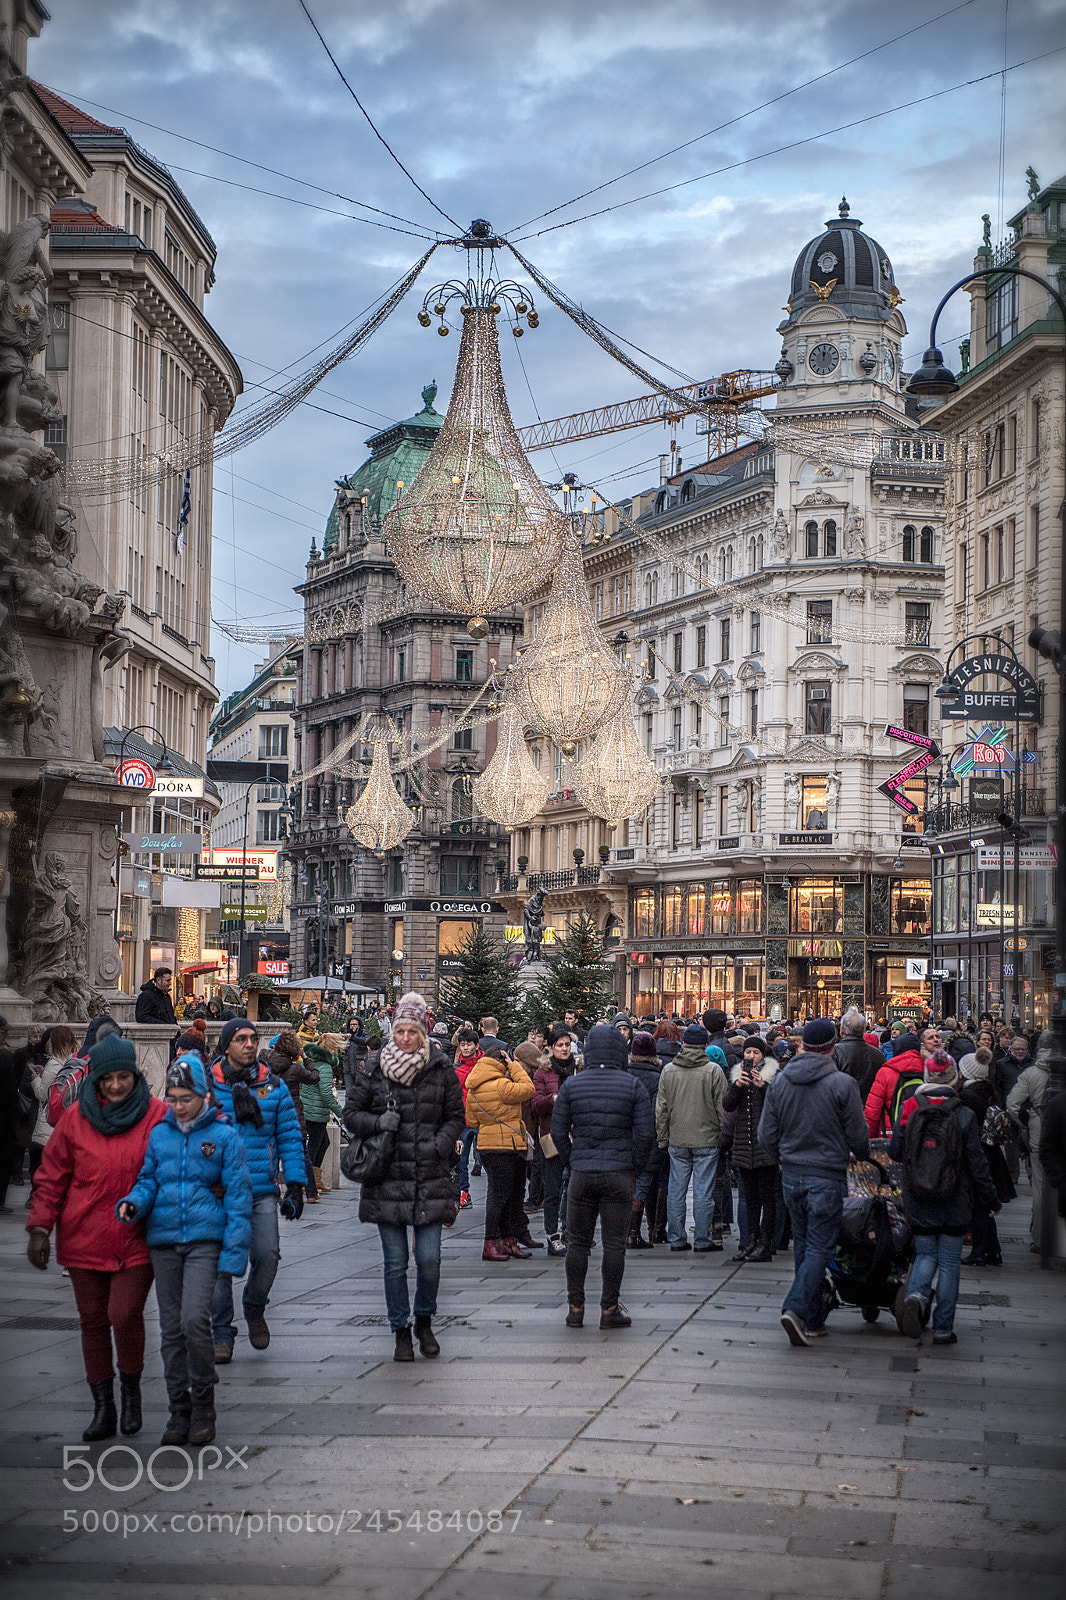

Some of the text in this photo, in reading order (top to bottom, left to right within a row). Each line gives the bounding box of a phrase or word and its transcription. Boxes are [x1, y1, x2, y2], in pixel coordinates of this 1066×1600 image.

[964, 694, 1017, 707] BUFFET
[889, 726, 932, 746] DISCOTHEQUE
[887, 754, 934, 791] FLEDERMAUS
[140, 836, 183, 851] Douglas
[226, 857, 264, 865] WIENER
[197, 868, 225, 876] GERRY
[265, 962, 287, 974] SALE
